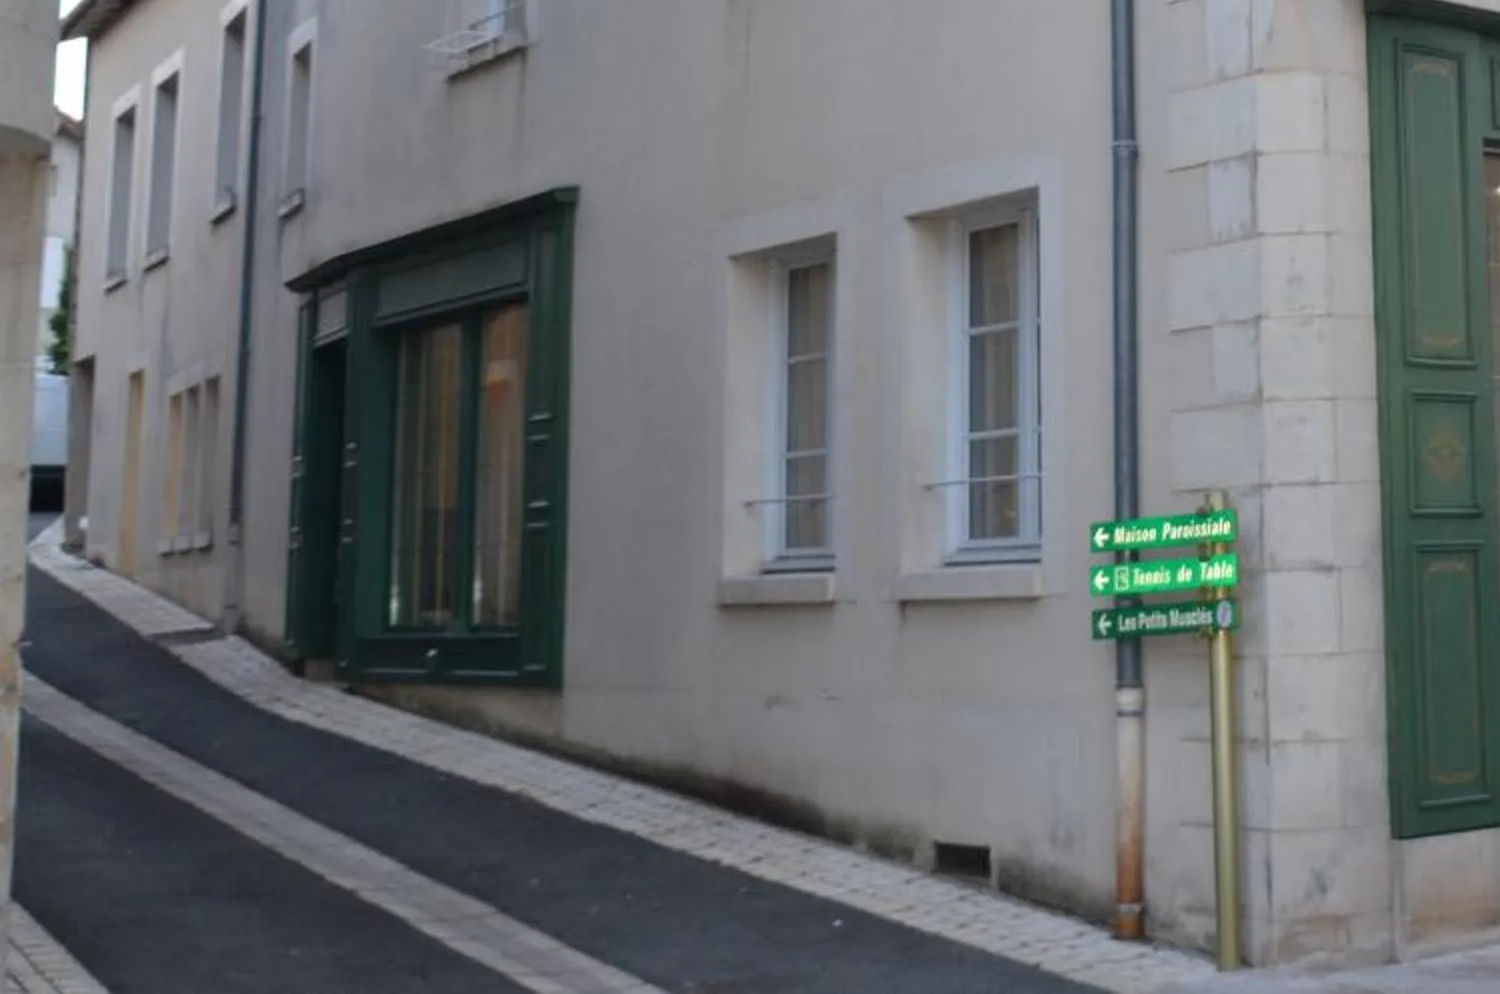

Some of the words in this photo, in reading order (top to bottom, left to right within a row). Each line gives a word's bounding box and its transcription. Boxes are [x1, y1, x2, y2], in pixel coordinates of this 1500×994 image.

[1113, 525, 1157, 544] Maison
[1161, 517, 1231, 540] Paroissiale
[1133, 566, 1171, 585] Tennis
[1177, 563, 1193, 582] de
[1200, 560, 1233, 581] Table
[1118, 614, 1137, 631] Les
